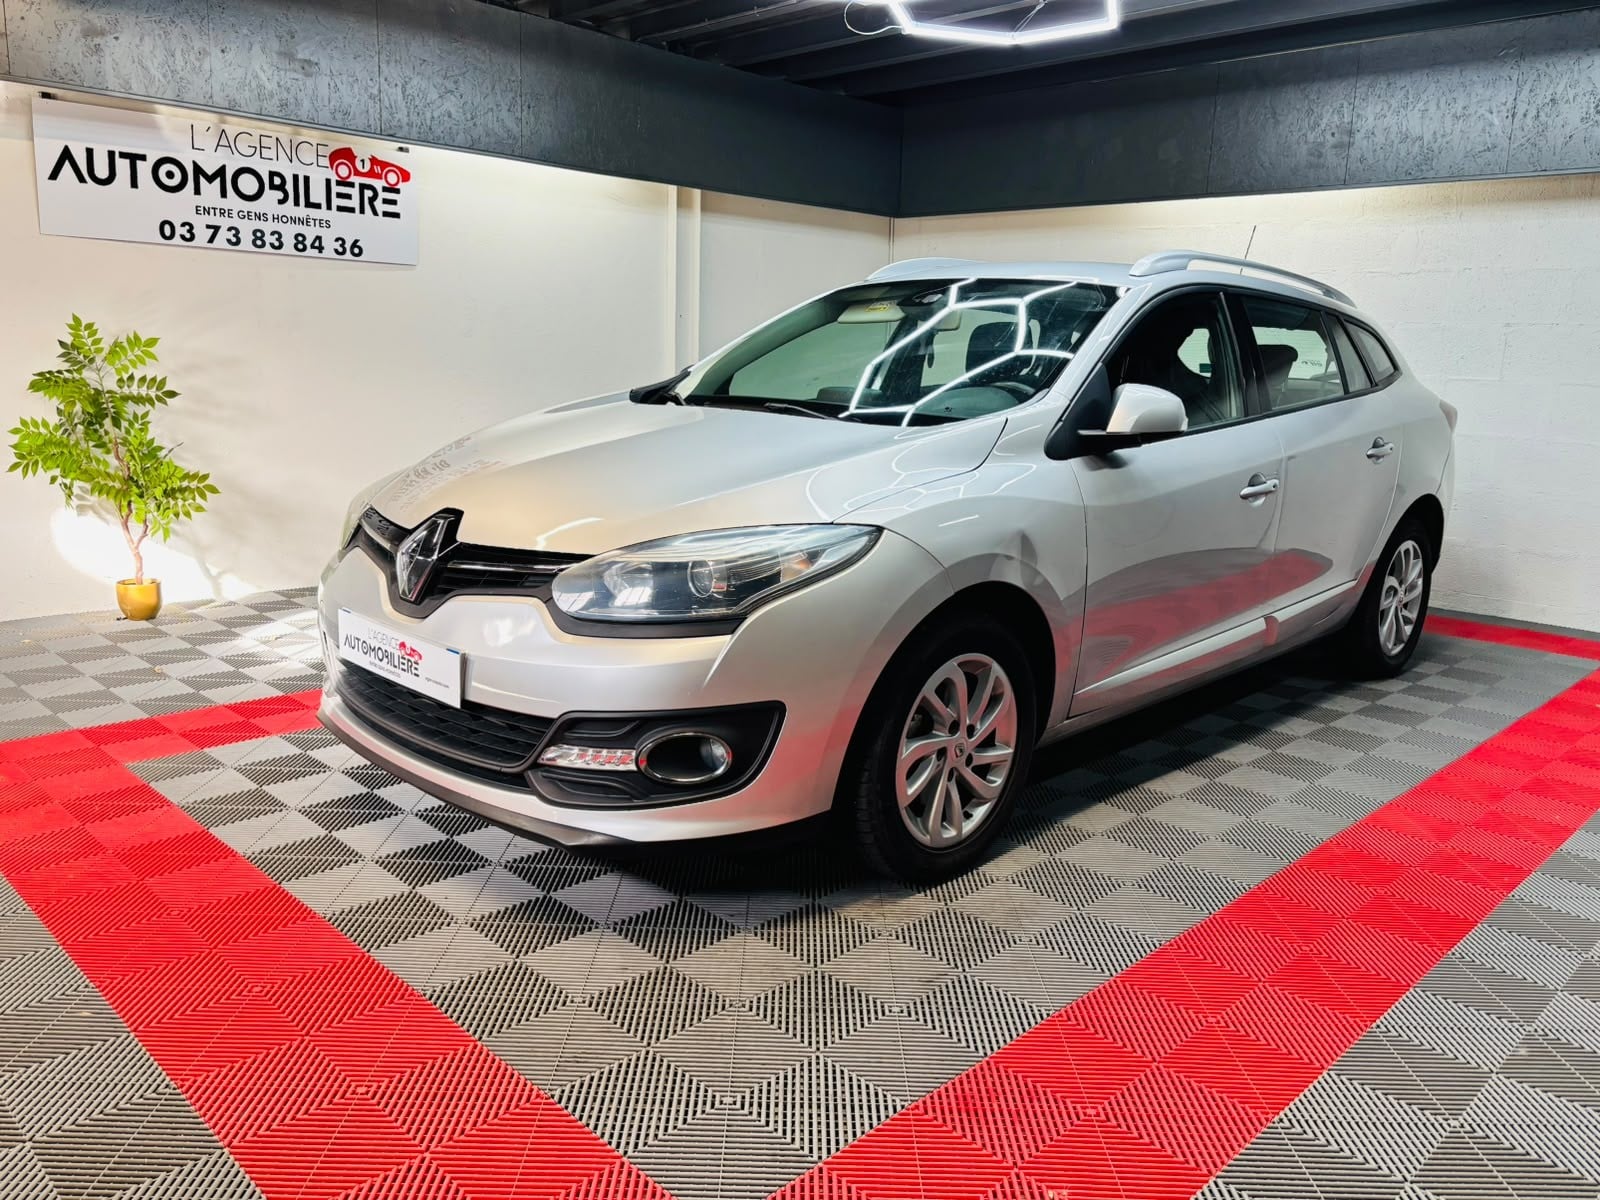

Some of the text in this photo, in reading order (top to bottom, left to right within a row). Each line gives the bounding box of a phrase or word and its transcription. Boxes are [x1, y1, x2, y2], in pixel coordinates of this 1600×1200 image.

[195, 205, 331, 229] ENTRE GENS HONNÊTES
[158, 219, 364, 258] 03 73 83 84 36
